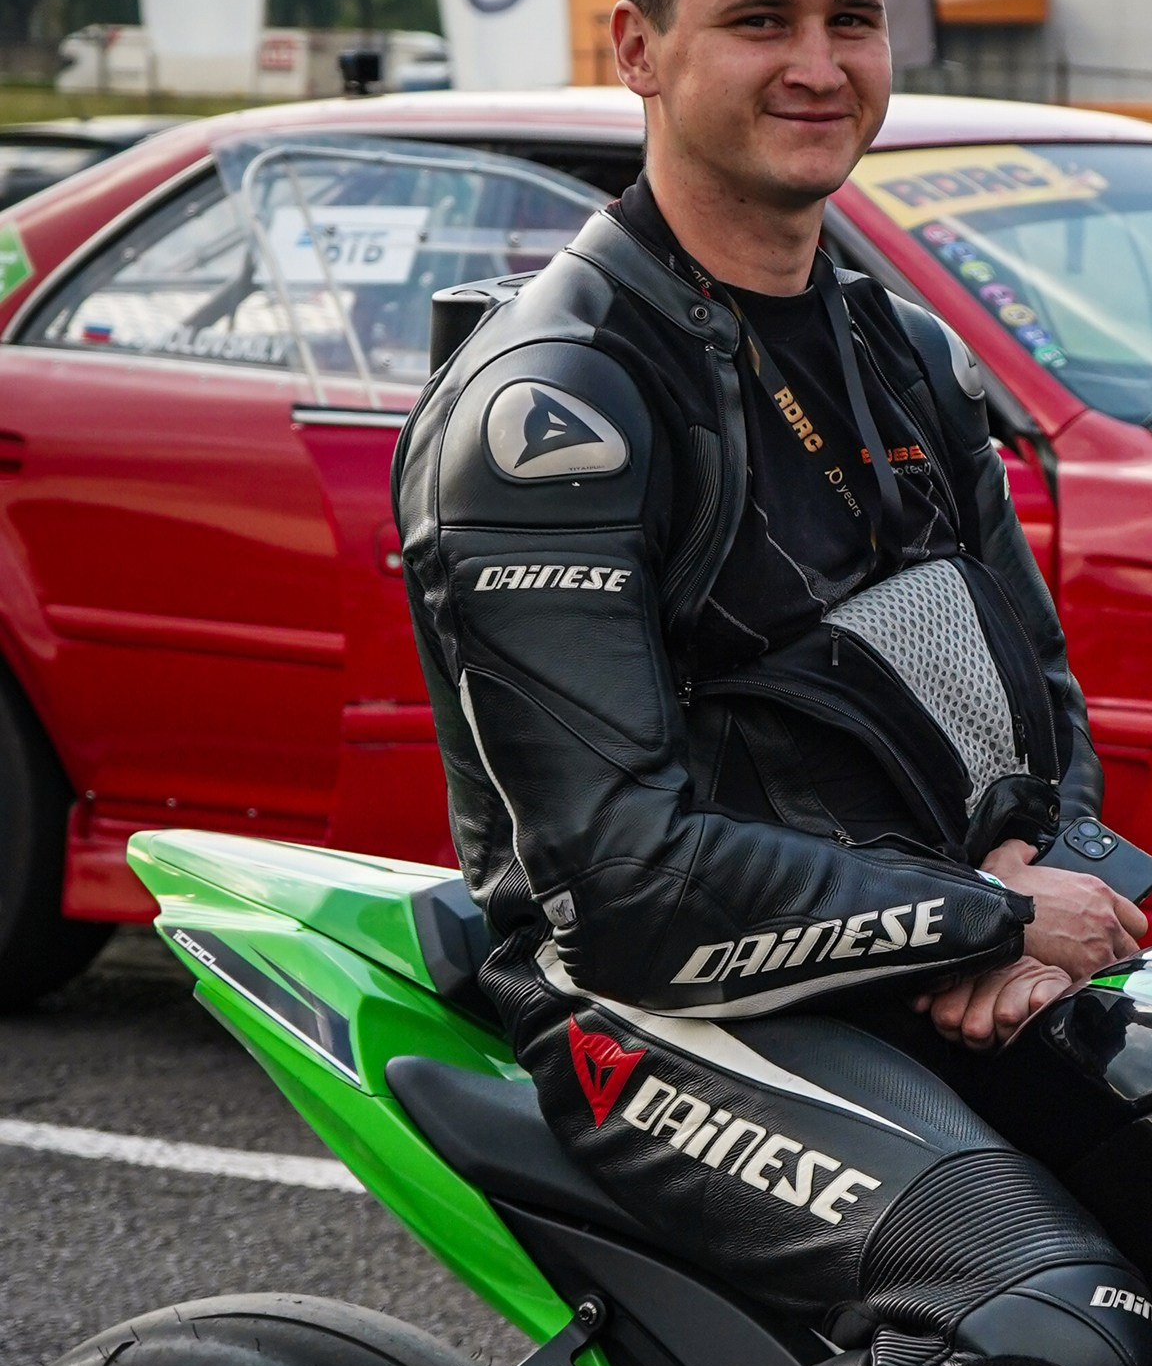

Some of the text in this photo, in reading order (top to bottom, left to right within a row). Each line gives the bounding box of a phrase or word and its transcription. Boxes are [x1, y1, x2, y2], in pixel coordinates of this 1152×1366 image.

[773, 386, 824, 453] RDRC
[837, 484, 862, 518] years
[173, 929, 216, 966] 1000
